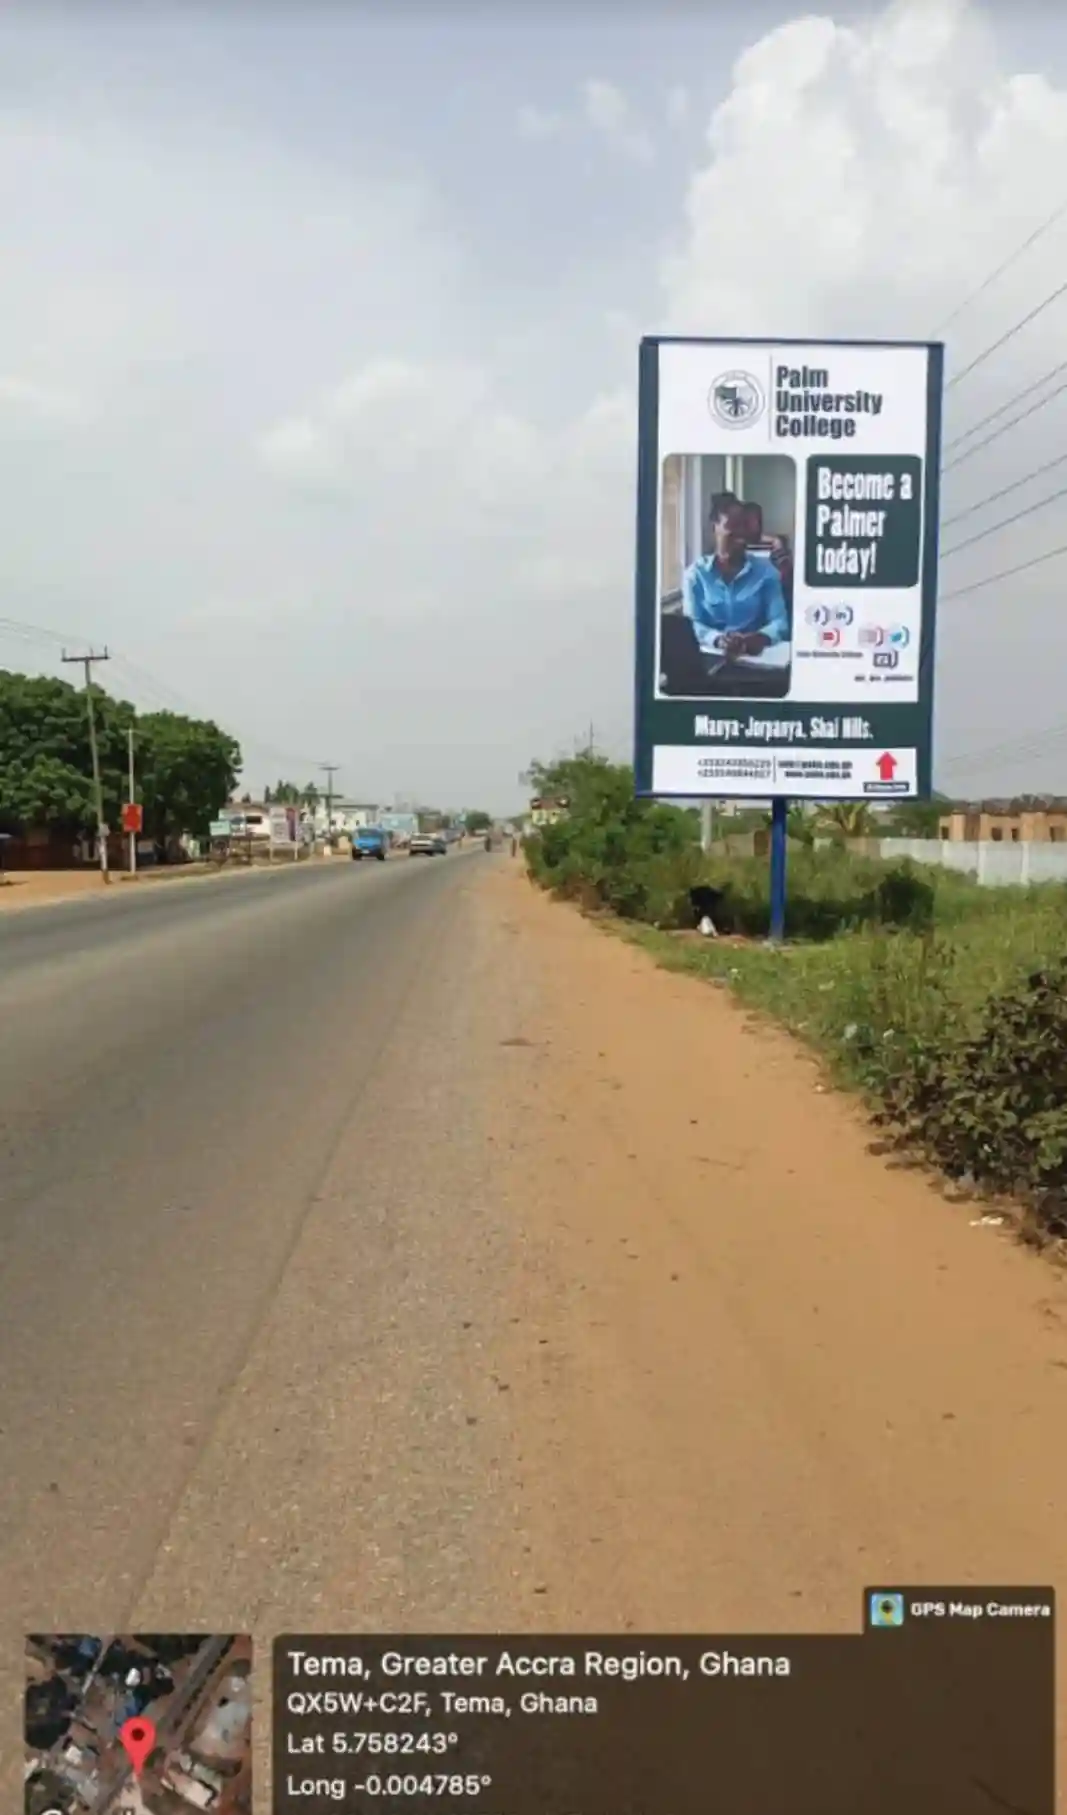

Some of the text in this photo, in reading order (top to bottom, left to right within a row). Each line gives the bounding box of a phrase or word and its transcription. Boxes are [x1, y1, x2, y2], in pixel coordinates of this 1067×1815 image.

[776, 365, 828, 388] Palm
[776, 390, 882, 415] University
[776, 414, 856, 439] College
[817, 467, 912, 500] Become a
[816, 504, 886, 537] Palmer
[816, 542, 877, 580] today!
[810, 716, 839, 738] Shai
